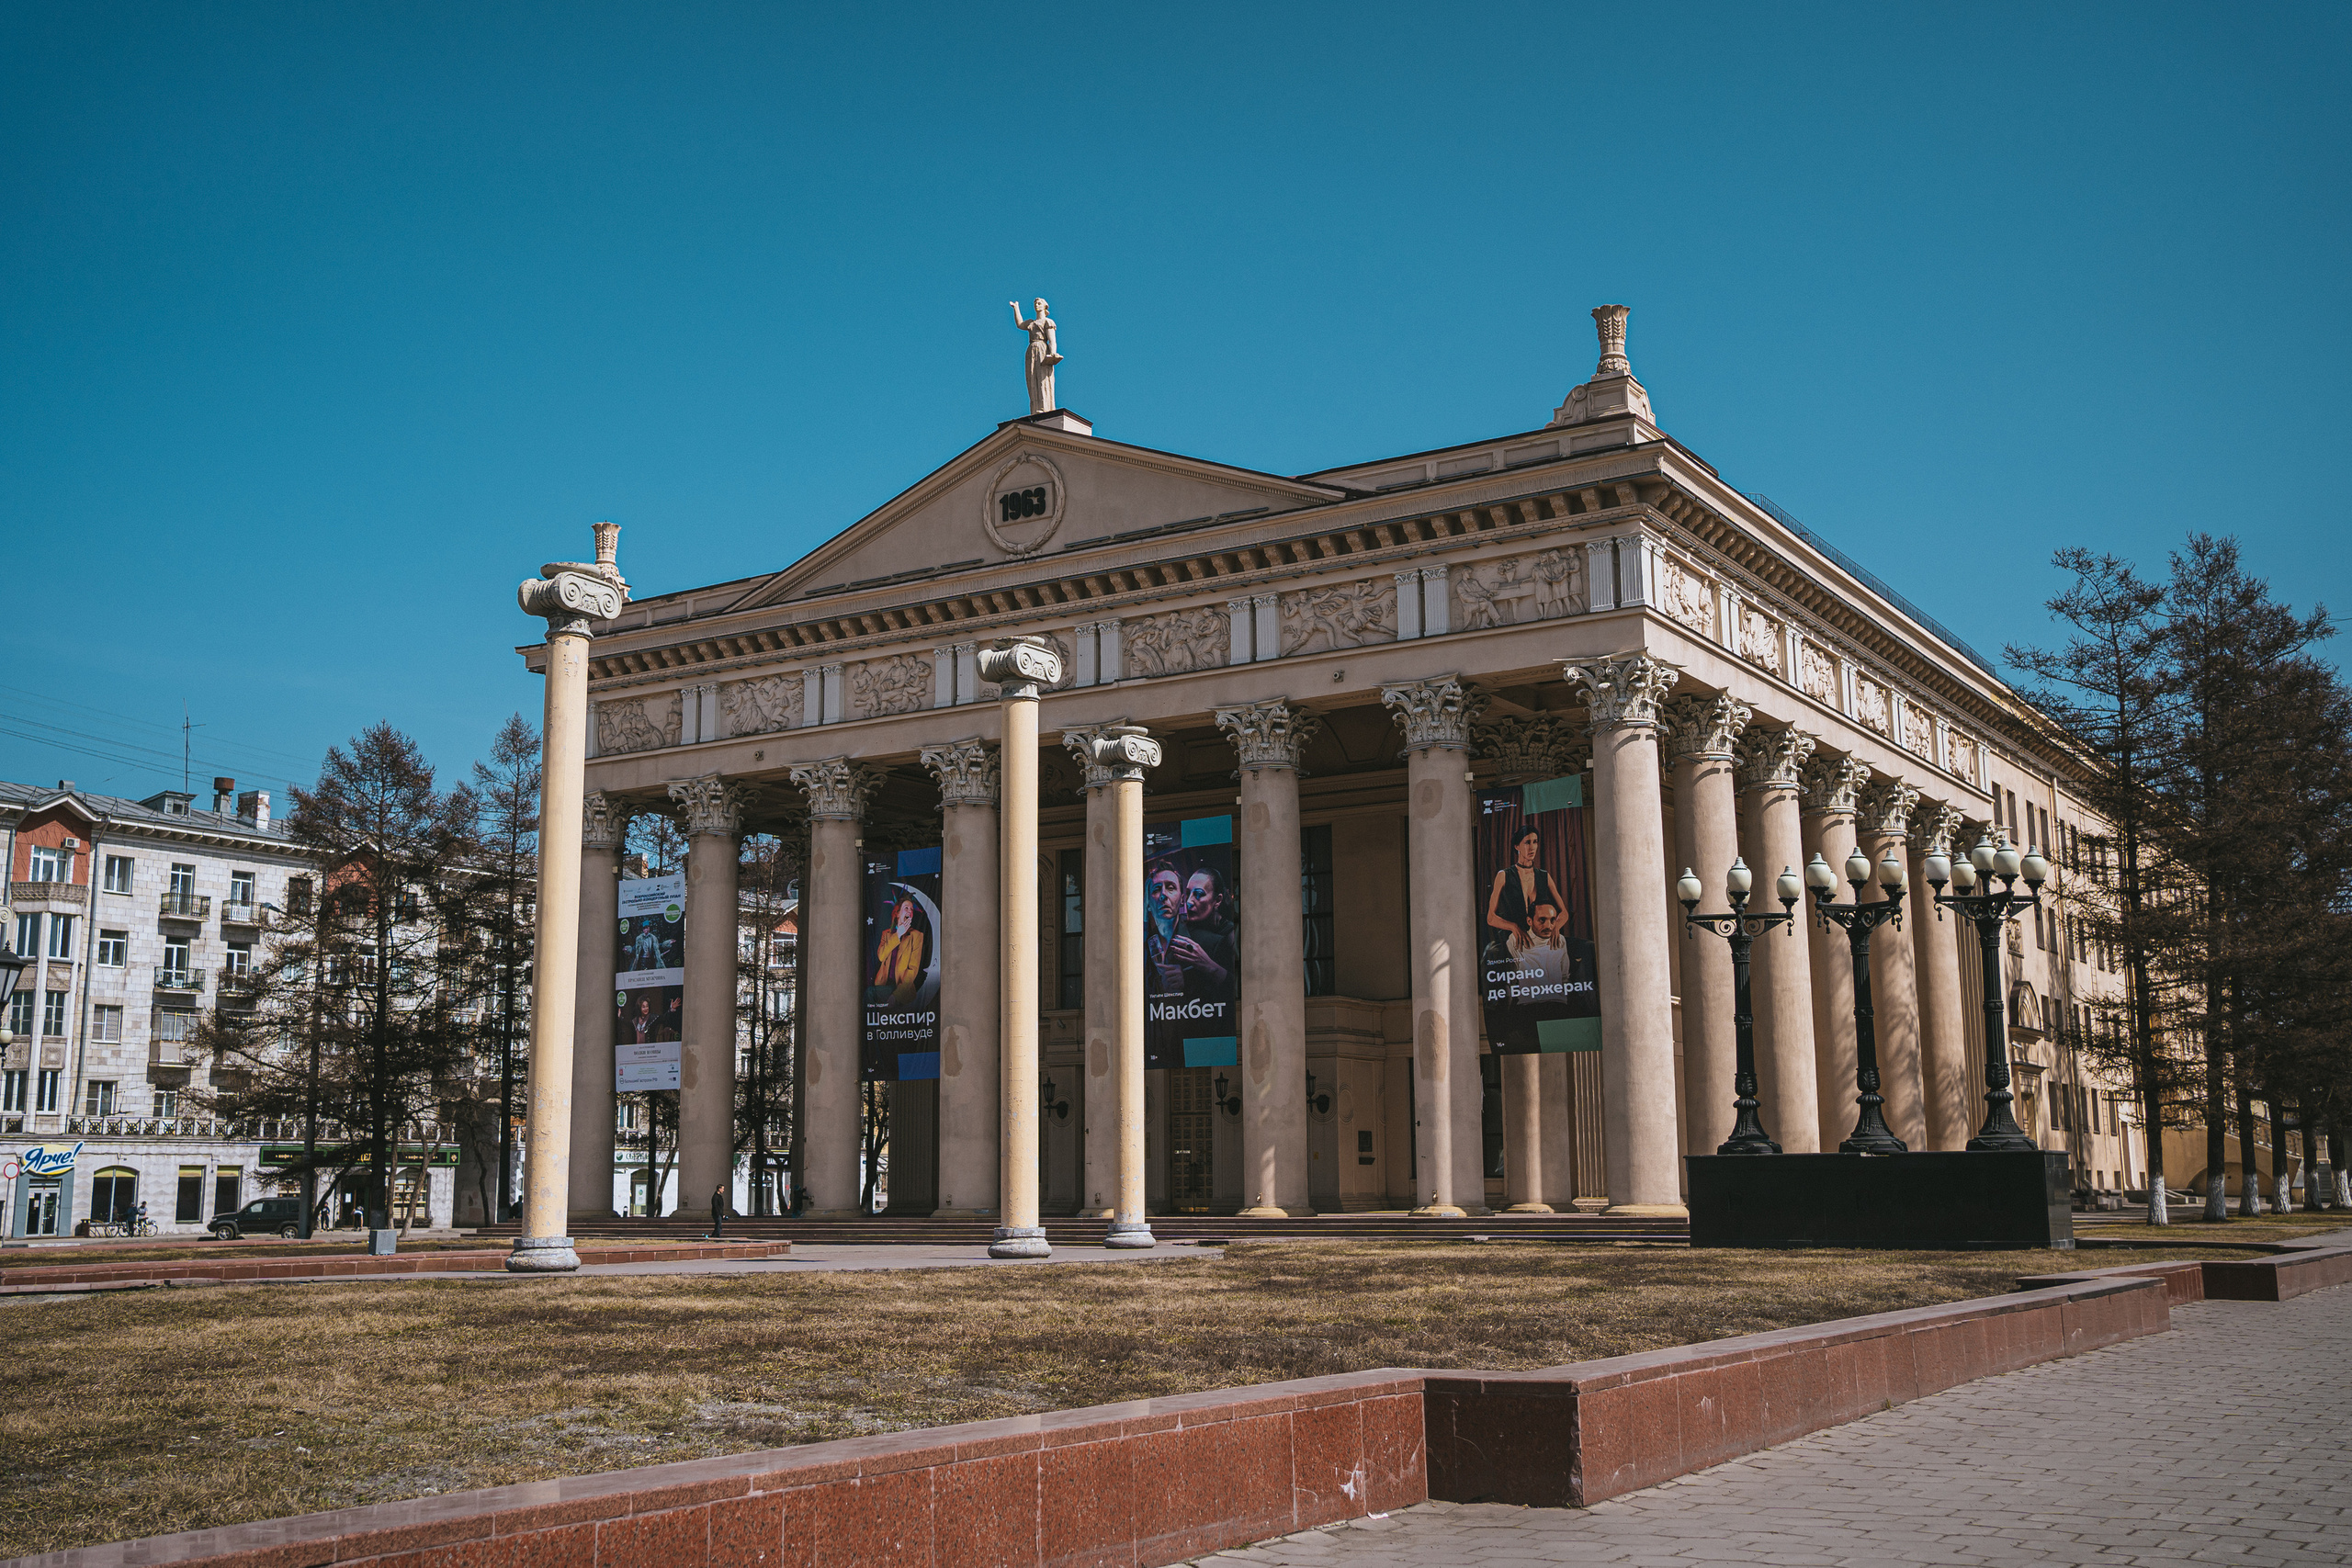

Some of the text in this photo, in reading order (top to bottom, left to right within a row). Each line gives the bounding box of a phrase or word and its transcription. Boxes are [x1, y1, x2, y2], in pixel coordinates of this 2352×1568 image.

[999, 487, 1046, 522] 1963
[1487, 968, 1544, 984] Сирано
[1487, 981, 1594, 1001] де Бержерак
[866, 1011, 936, 1026] Шекспир
[1149, 998, 1227, 1021] Макбет
[866, 1029, 933, 1041] в Голливуде
[23, 1142, 84, 1172] Ярче!
